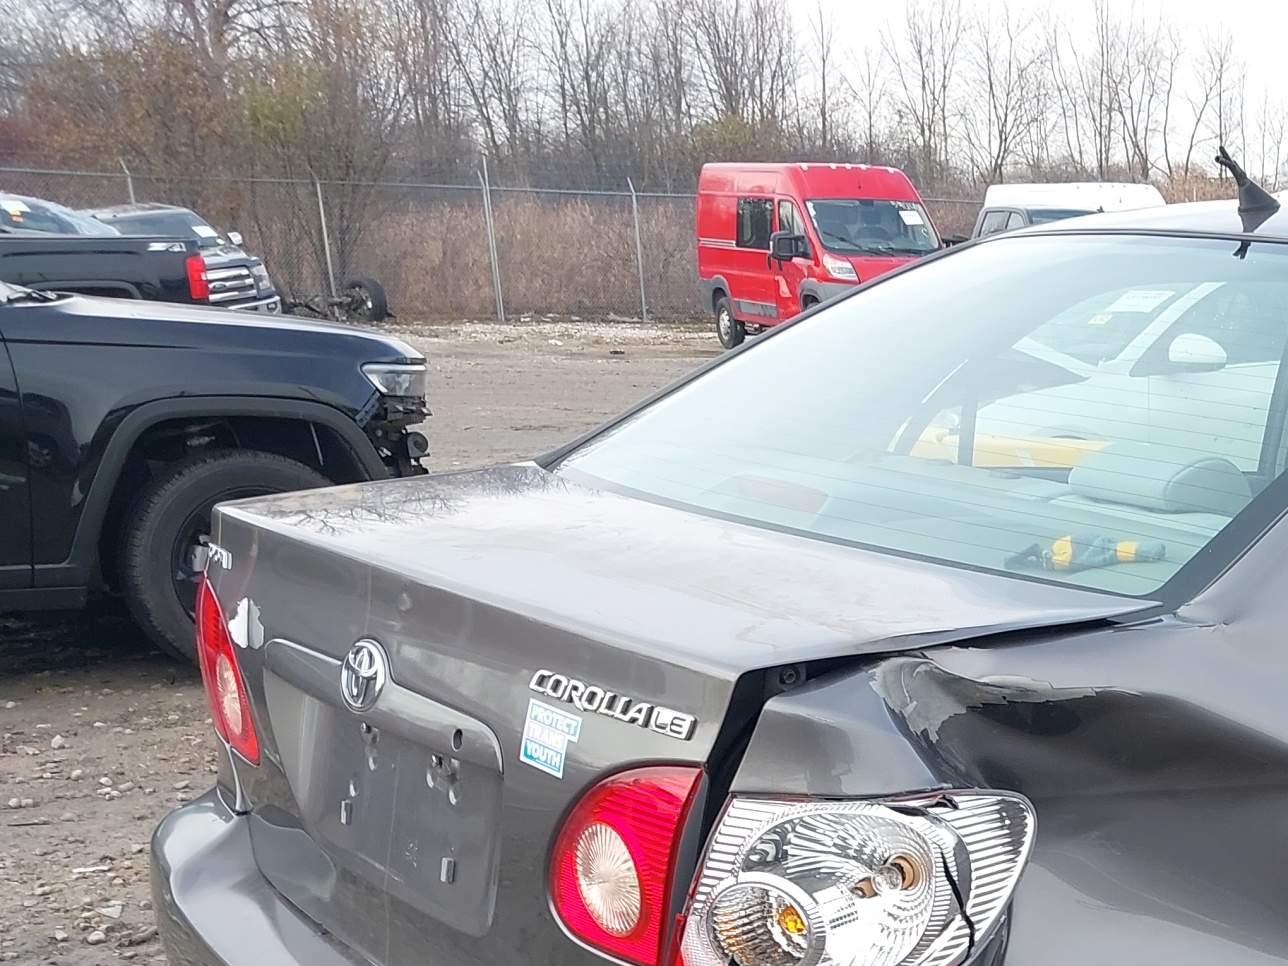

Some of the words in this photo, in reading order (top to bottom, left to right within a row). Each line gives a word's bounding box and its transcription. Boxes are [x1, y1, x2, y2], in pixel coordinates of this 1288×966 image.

[529, 669, 650, 728] COROLLA
[652, 707, 694, 739] LE
[530, 703, 578, 737] PROTECT
[527, 721, 565, 750] TRANS
[526, 739, 562, 769] YOUTH
